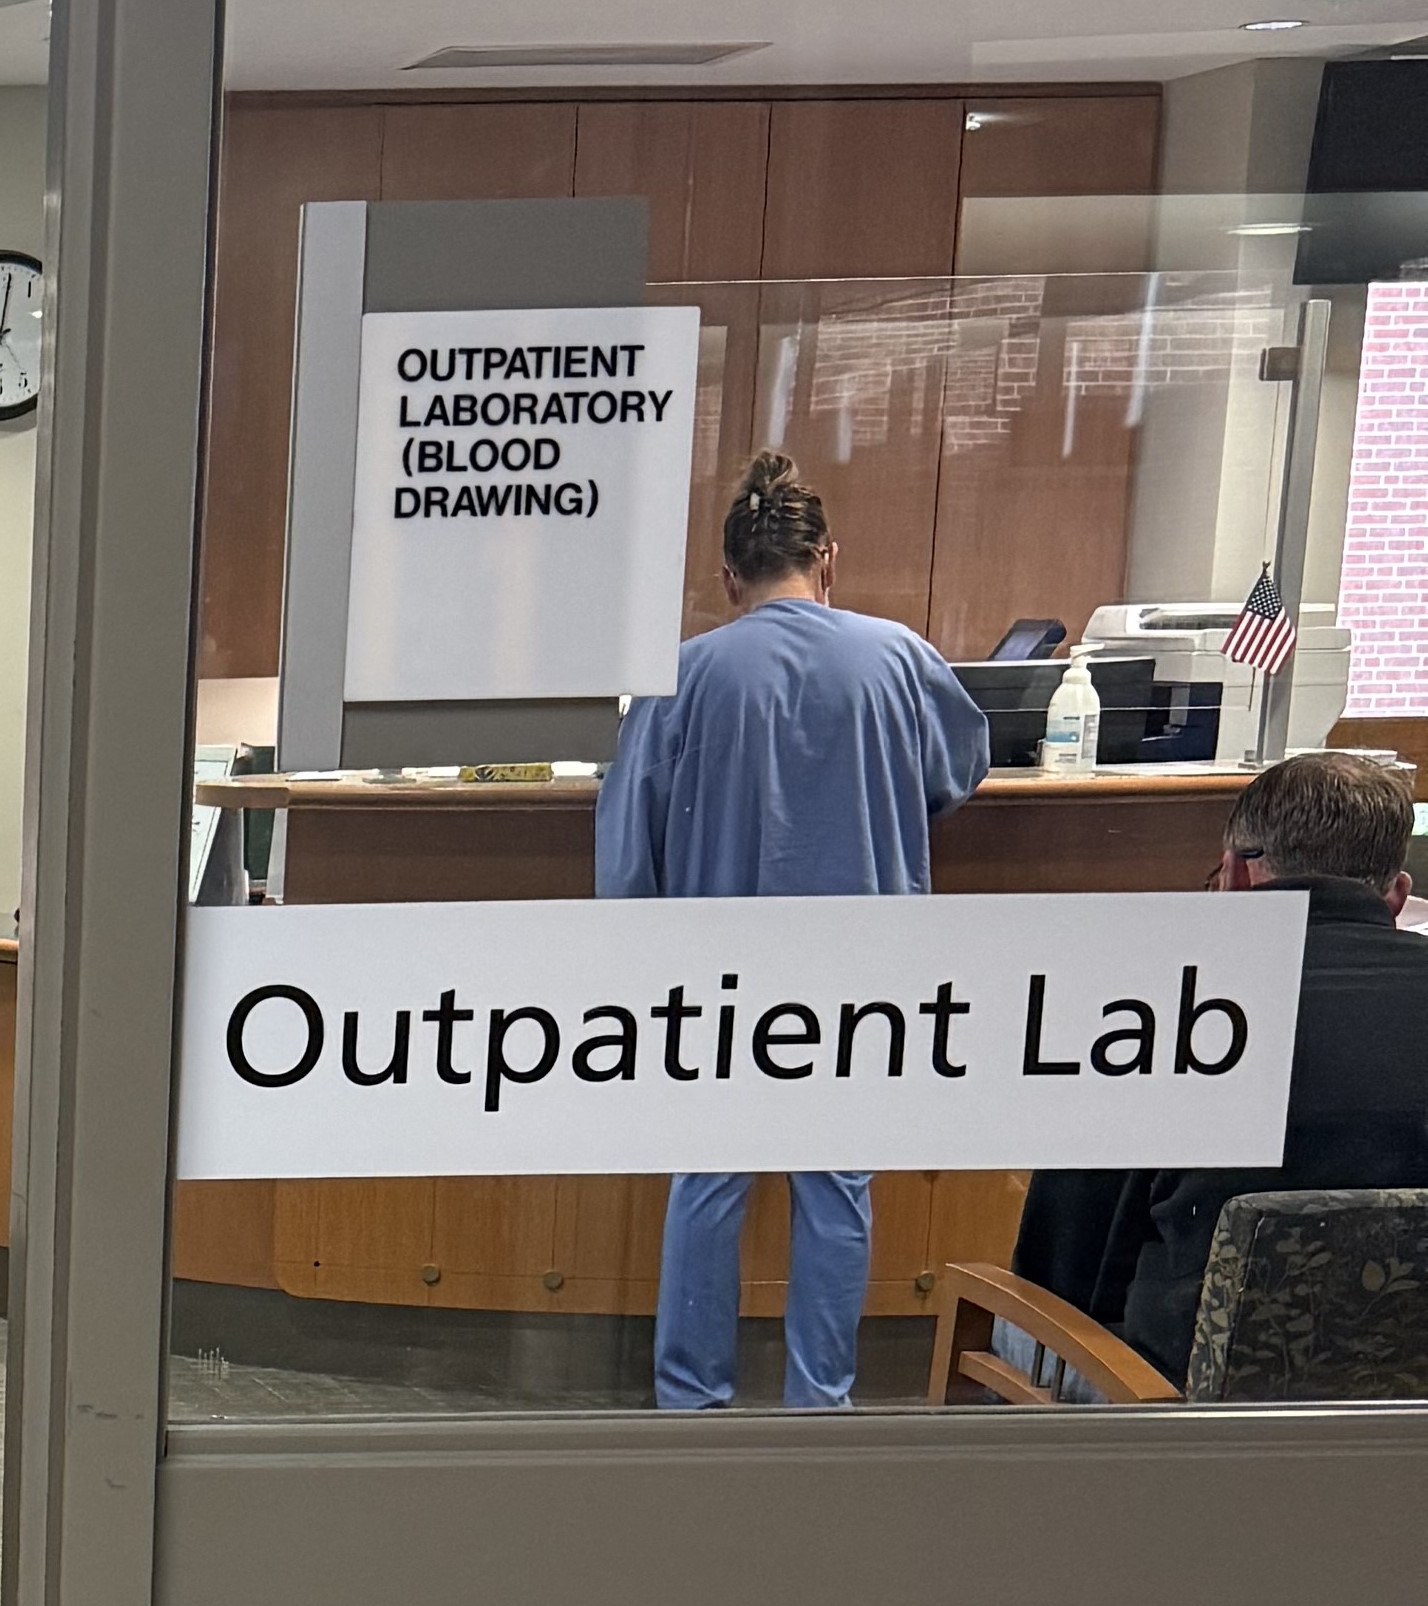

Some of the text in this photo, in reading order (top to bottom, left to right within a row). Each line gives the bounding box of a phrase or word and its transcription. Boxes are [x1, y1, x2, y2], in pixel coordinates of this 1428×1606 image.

[27, 281, 32, 298] 1
[18, 371, 28, 388] 5
[397, 344, 646, 383] OUTPATIENT
[399, 389, 674, 428] LABORATORY
[402, 437, 561, 477] (BLOOD
[394, 479, 599, 519] DRAWING)
[226, 965, 1249, 1112] Outpatient Lab
